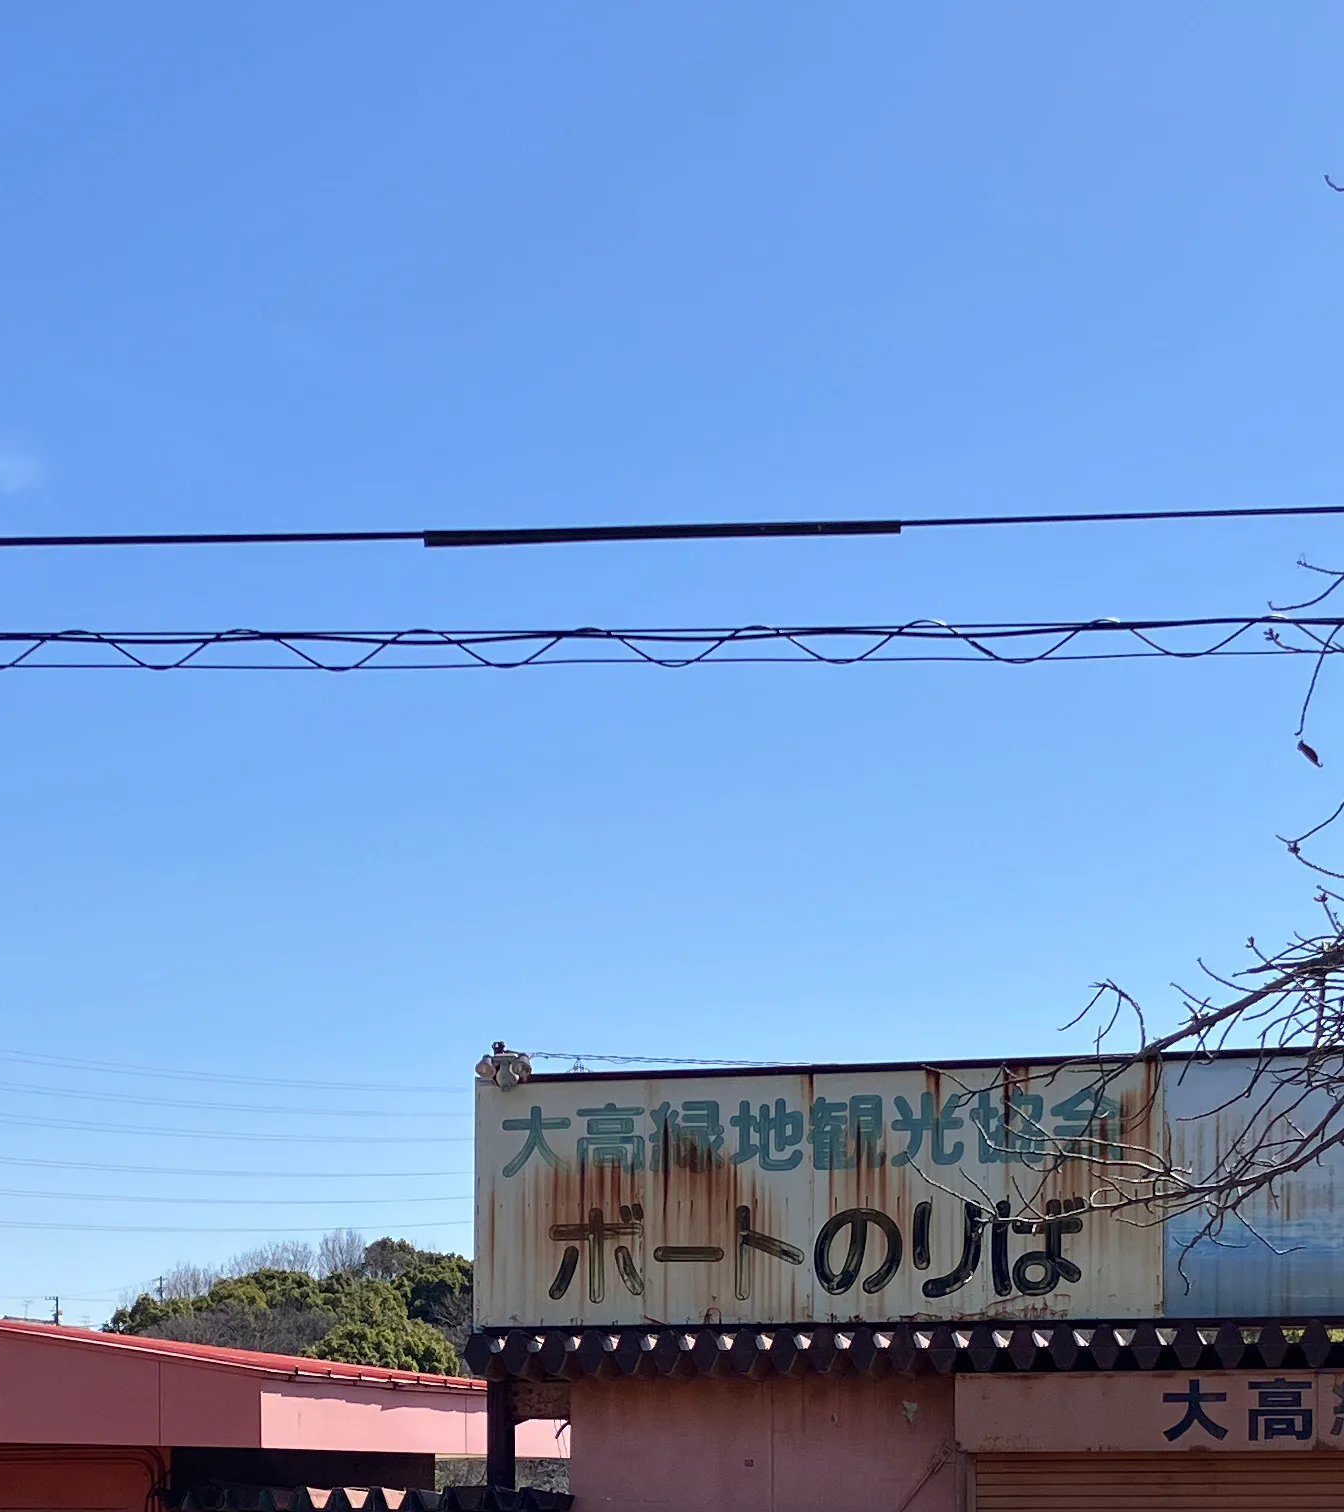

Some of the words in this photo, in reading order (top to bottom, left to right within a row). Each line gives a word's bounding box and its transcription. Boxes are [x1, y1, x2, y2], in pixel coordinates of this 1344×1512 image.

[502, 1090, 1125, 1178] 大高緑地観光協会
[548, 1200, 1085, 1303] ボートのりば
